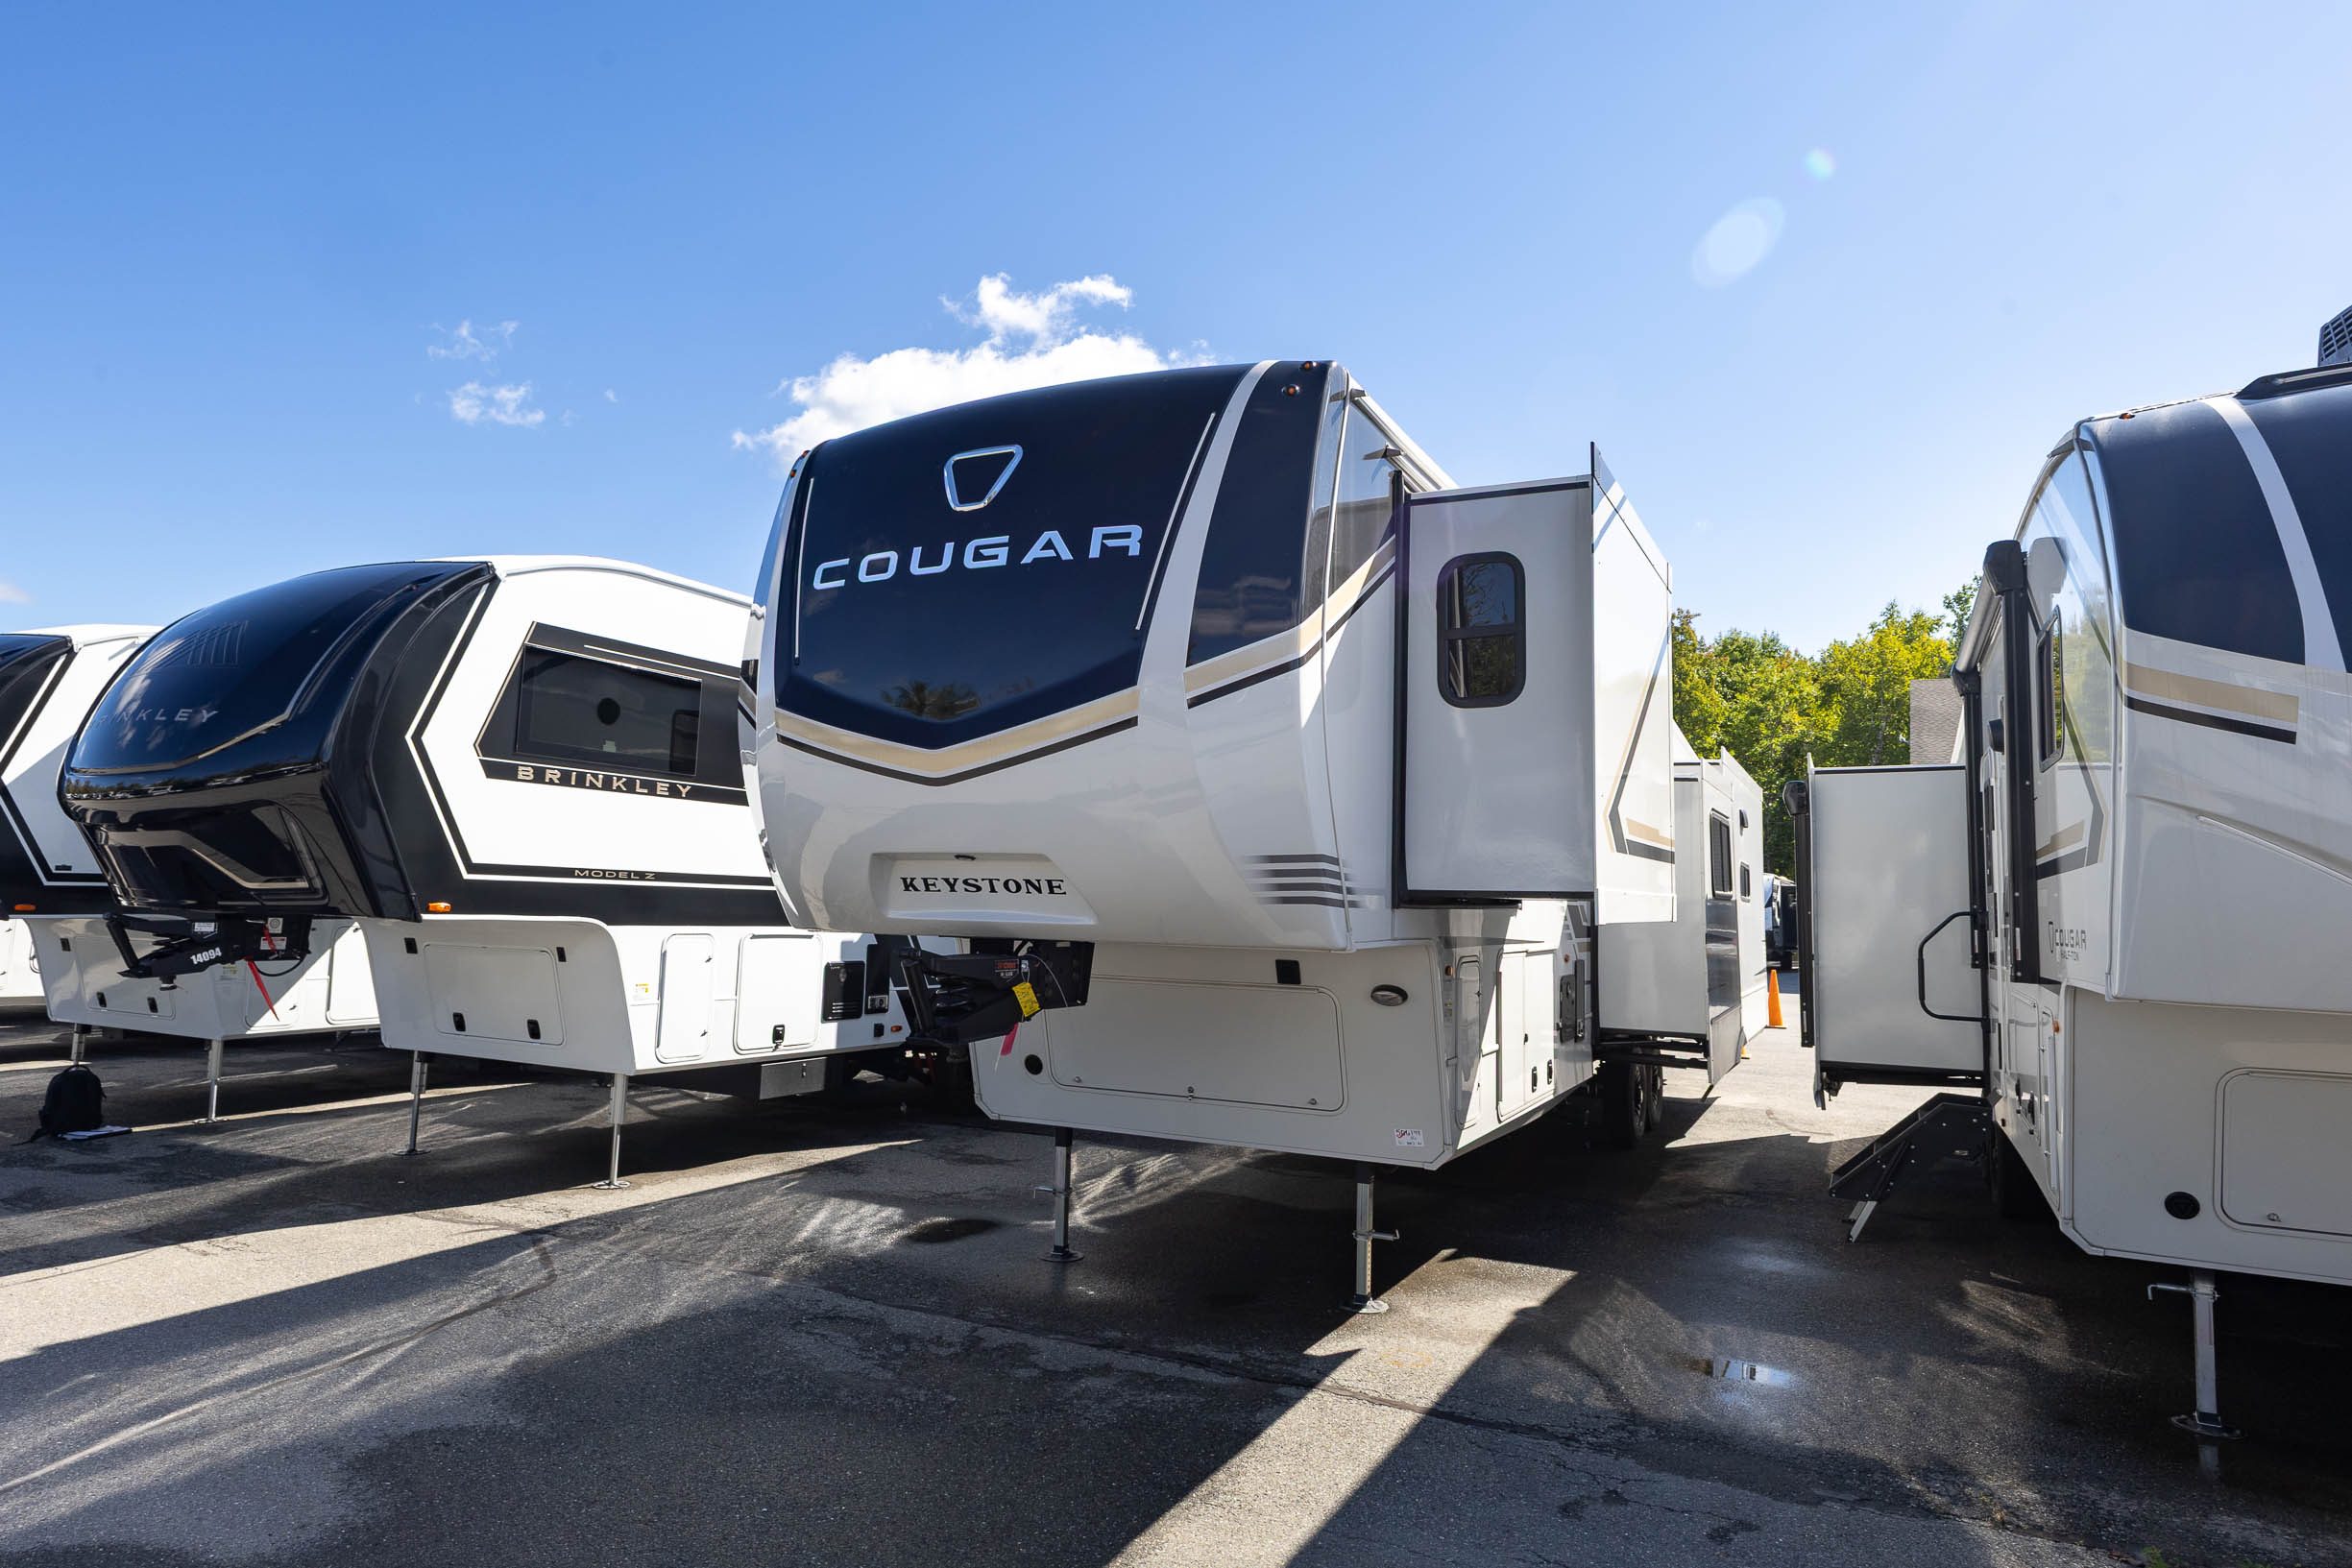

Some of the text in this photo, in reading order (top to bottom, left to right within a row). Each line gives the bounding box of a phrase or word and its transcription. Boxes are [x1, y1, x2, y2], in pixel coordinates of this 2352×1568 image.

[812, 524, 1143, 591] COUGAR
[517, 765, 691, 798] BRINKLEY
[574, 869, 640, 880] MODEL
[900, 877, 1067, 895] KEYSTONE
[2055, 929, 2087, 951] COUGAR
[190, 947, 223, 965] 14094
